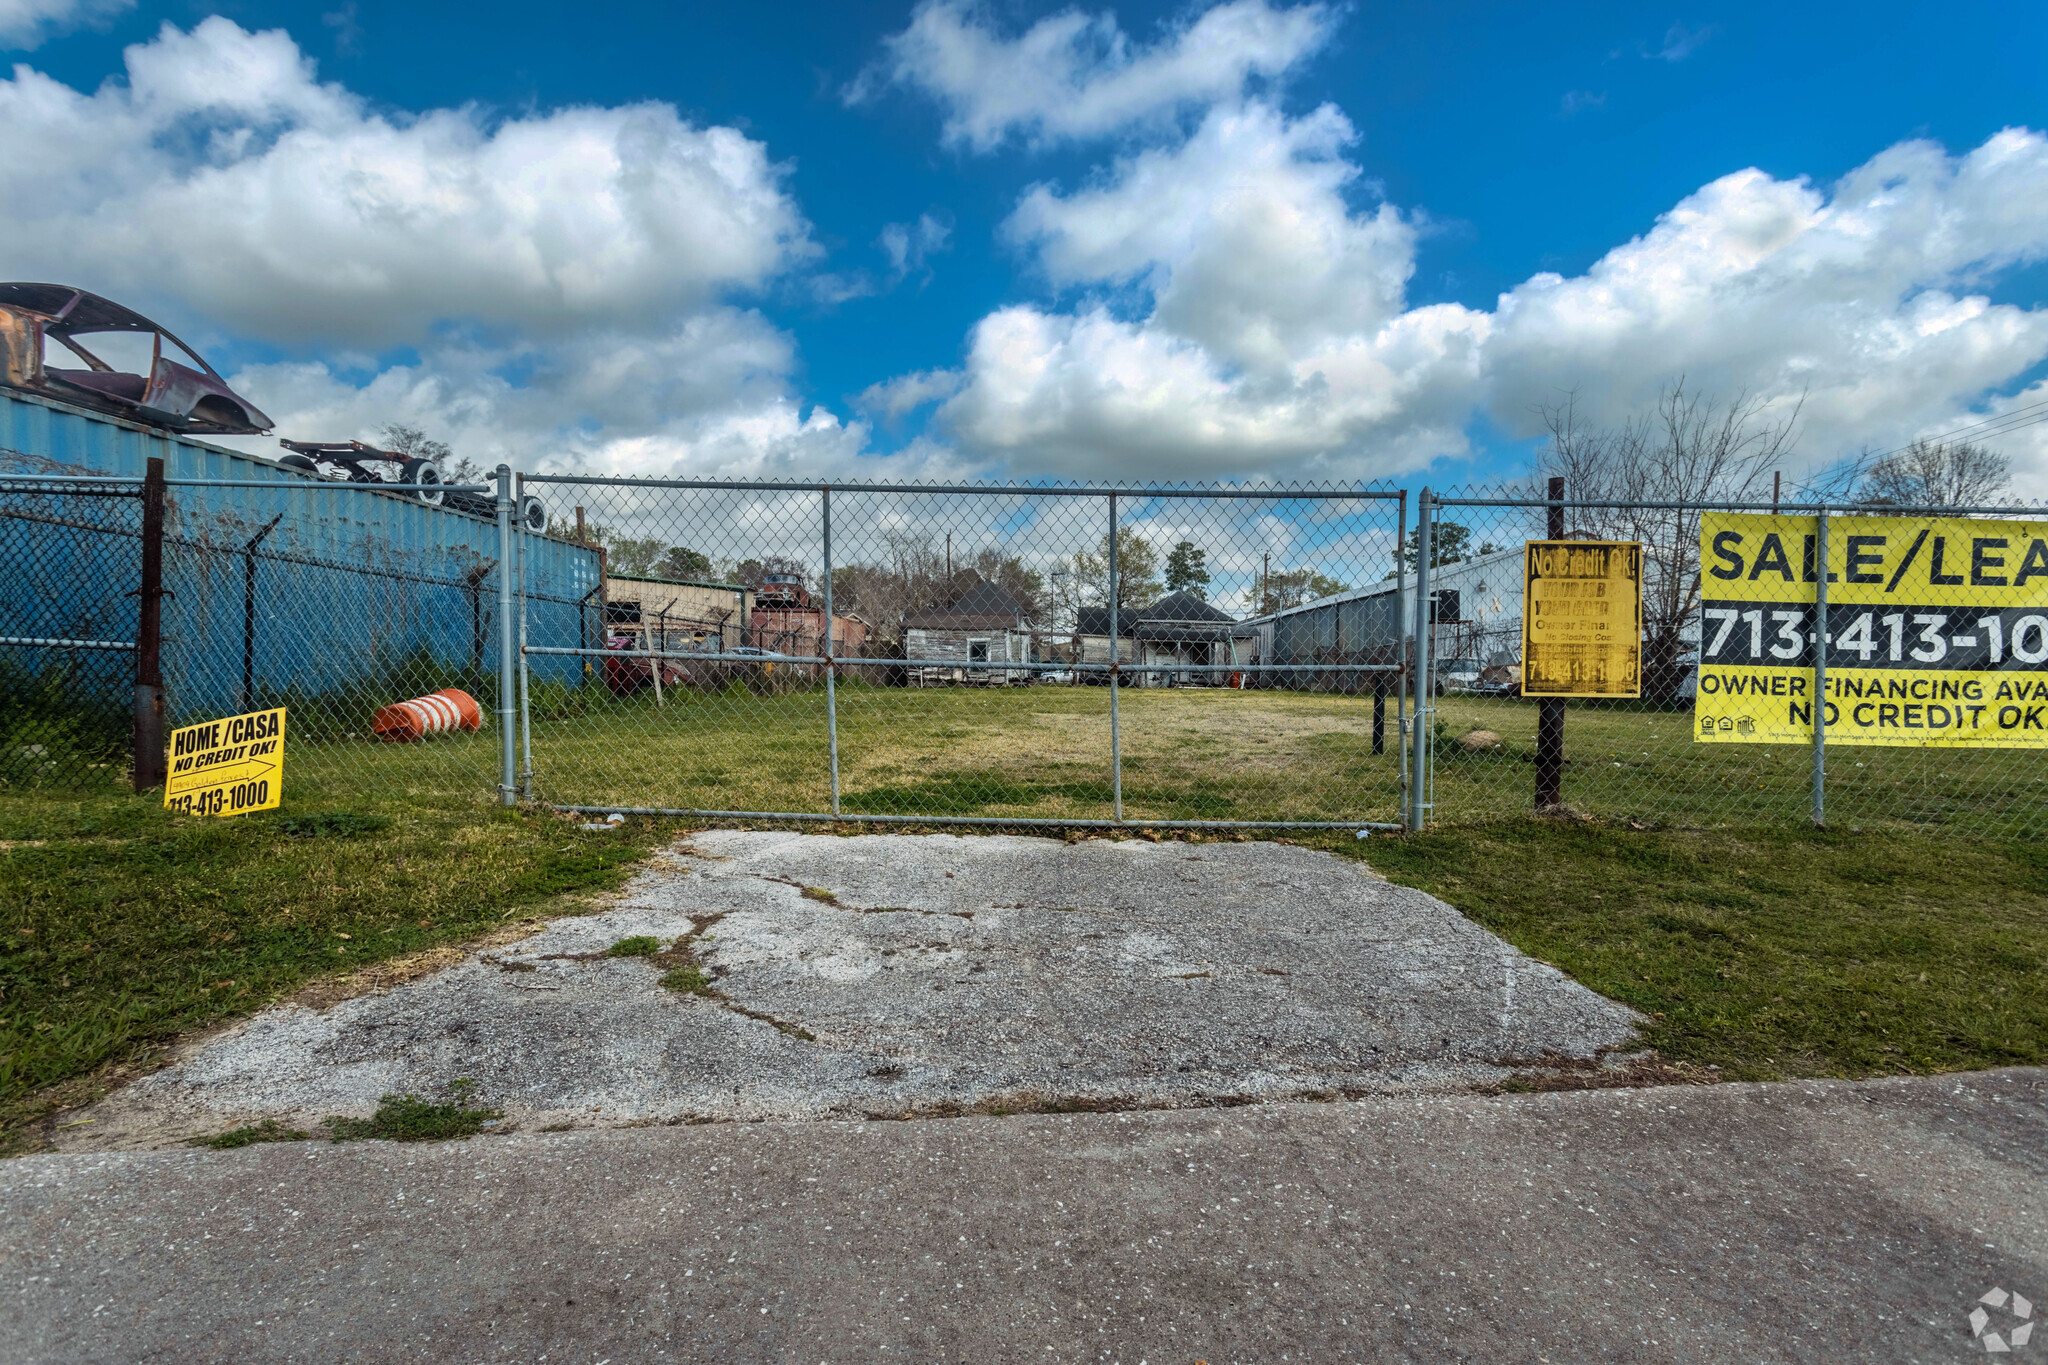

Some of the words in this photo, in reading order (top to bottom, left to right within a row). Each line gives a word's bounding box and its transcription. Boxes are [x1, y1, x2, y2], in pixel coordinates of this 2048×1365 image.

[1531, 548, 1552, 575] No
[1557, 547, 1605, 575] Credit
[1609, 549, 1636, 575] Ok!
[1709, 529, 2048, 593] SALE/LEA
[1705, 609, 2048, 664] 713-413-10
[1528, 661, 1635, 681] 713-413-1000
[1700, 674, 1806, 697] OWNER
[1823, 677, 1984, 701] FINANCING
[1995, 680, 2048, 701] AVA
[1789, 701, 1840, 727] NO
[1853, 703, 1987, 729] CREDIT
[174, 724, 220, 757] HOME
[223, 712, 279, 746] /CASA
[174, 757, 194, 773] NO
[196, 746, 248, 768] CREDIT
[249, 740, 278, 757] OK!
[169, 780, 268, 815] 713-413-1000
